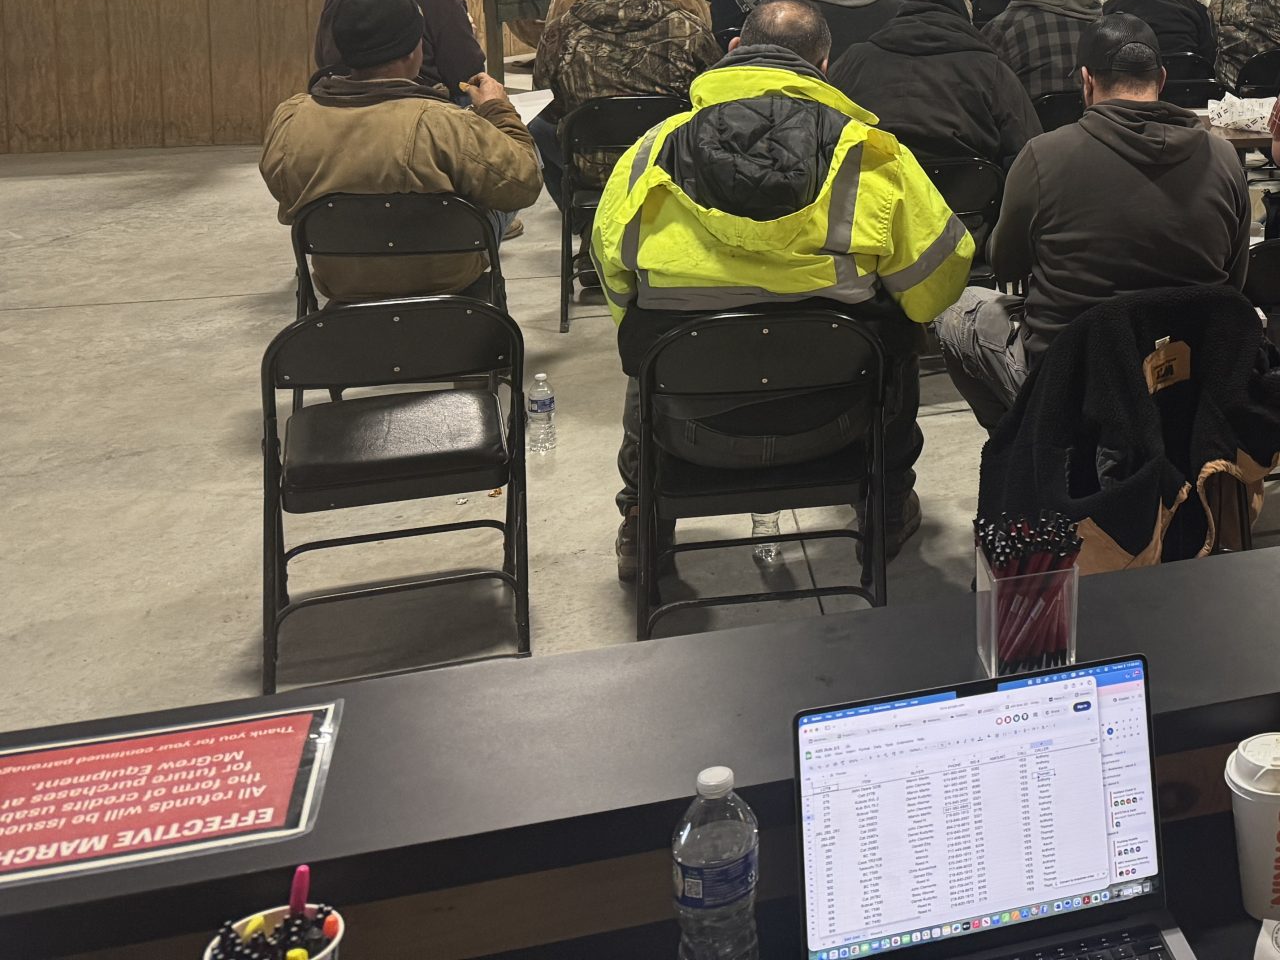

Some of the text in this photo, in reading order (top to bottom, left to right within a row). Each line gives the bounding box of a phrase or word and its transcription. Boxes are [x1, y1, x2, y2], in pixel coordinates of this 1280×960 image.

[250, 726, 294, 738] Thank
[30, 750, 244, 786] McGrew Equipment.
[30, 760, 252, 801] for future purchases
[61, 772, 261, 812] the form of credits
[72, 790, 234, 824] refunds will be
[112, 807, 274, 848] EFFECTIVE
